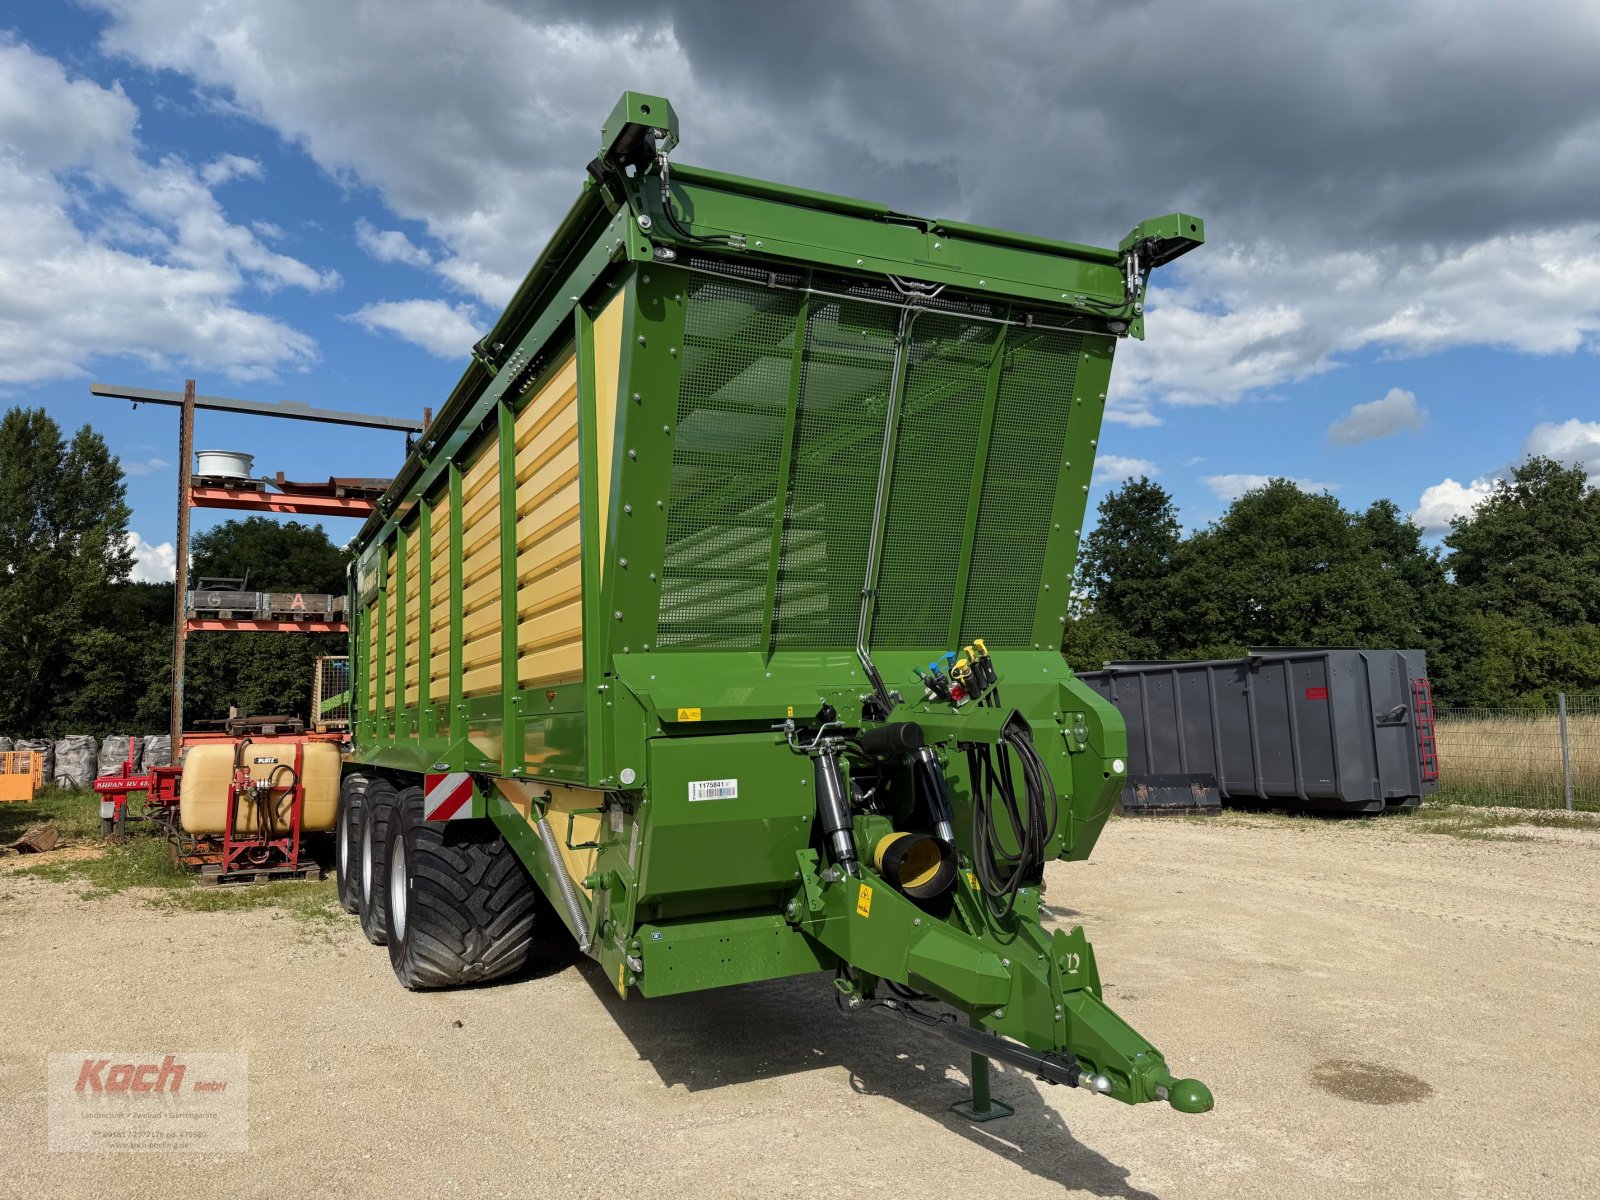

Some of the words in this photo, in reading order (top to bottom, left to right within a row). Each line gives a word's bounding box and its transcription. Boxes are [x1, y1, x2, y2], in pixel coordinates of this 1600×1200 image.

[291, 593, 306, 610] A
[97, 780, 124, 788] KRPAN
[806, 875, 811, 884] 3
[812, 900, 817, 909] 5
